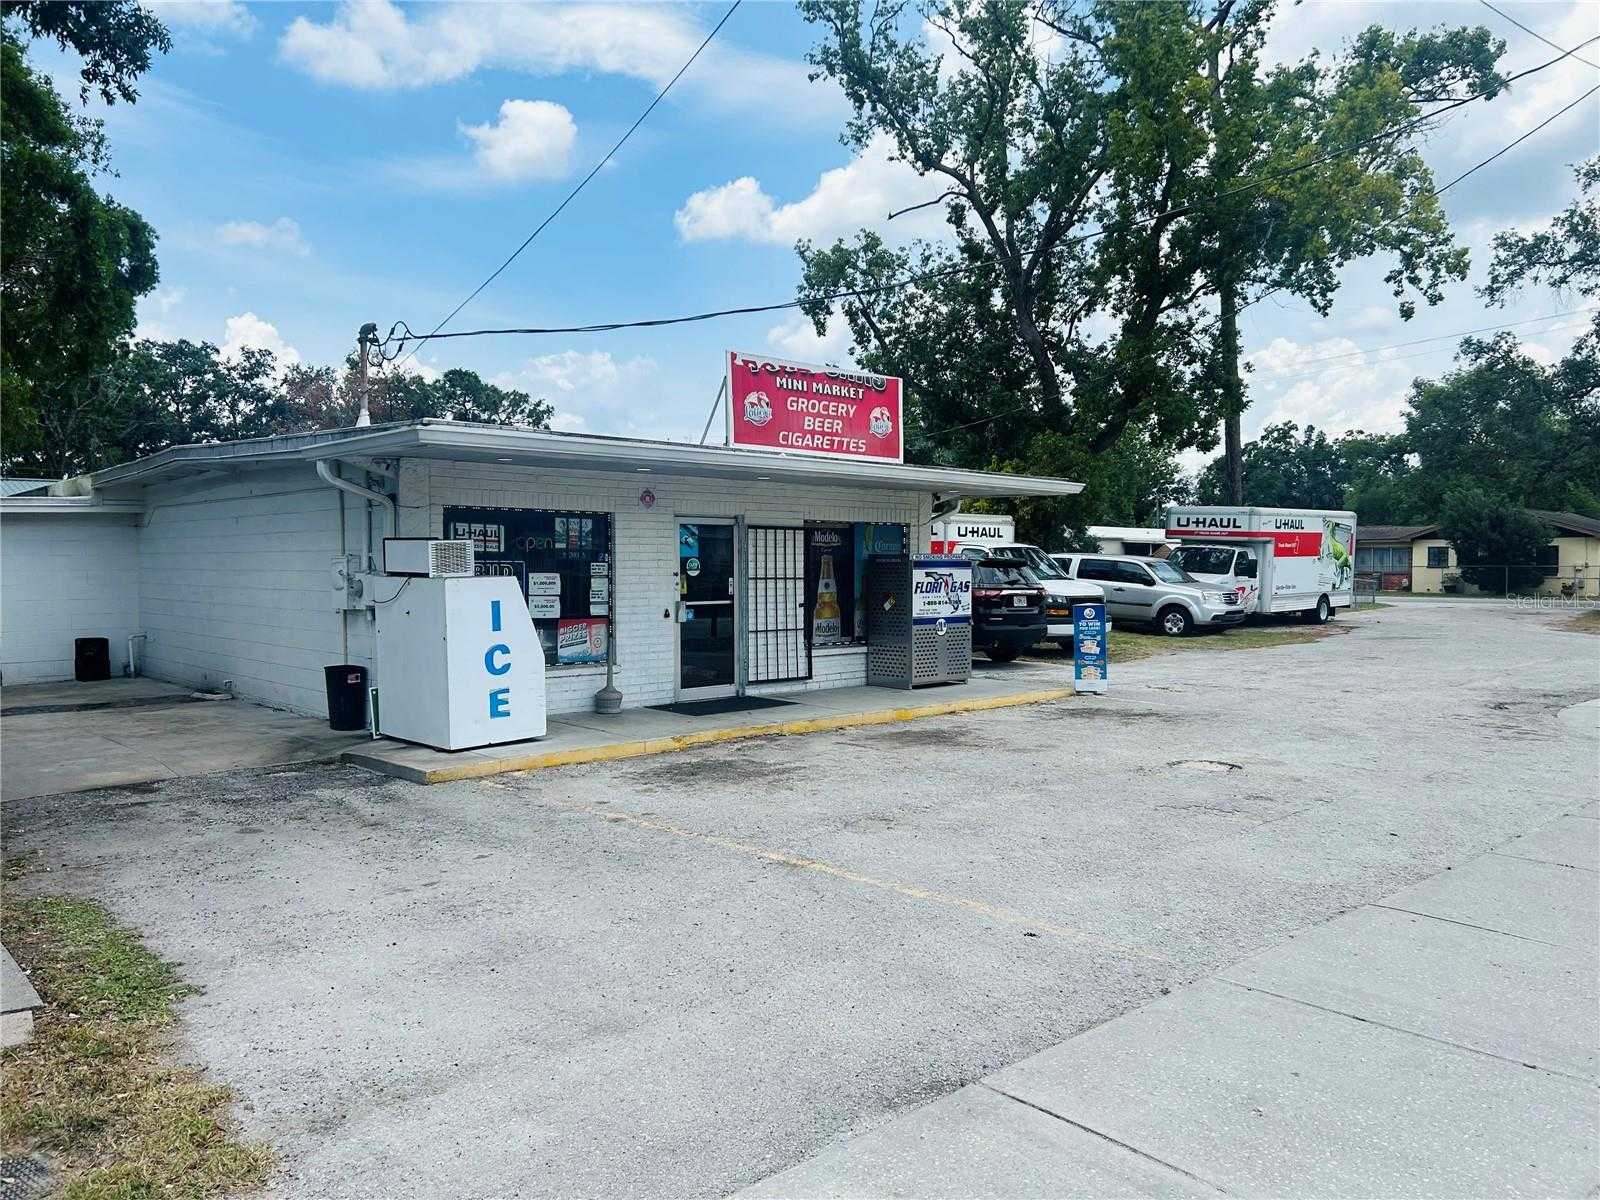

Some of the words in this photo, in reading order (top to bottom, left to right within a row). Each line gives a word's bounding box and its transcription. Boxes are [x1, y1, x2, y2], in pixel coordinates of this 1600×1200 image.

[776, 376, 808, 392] MINI
[812, 381, 866, 401] MARKET
[786, 396, 857, 418] GROCERY
[803, 416, 843, 434] BEER
[778, 431, 867, 452] CIGARETTES
[957, 526, 1004, 538] U-HAUL
[1176, 517, 1242, 529] U-HAUL
[1275, 518, 1304, 530] U-HAUL
[813, 530, 839, 544] Modelo
[484, 600, 512, 719] ICE
